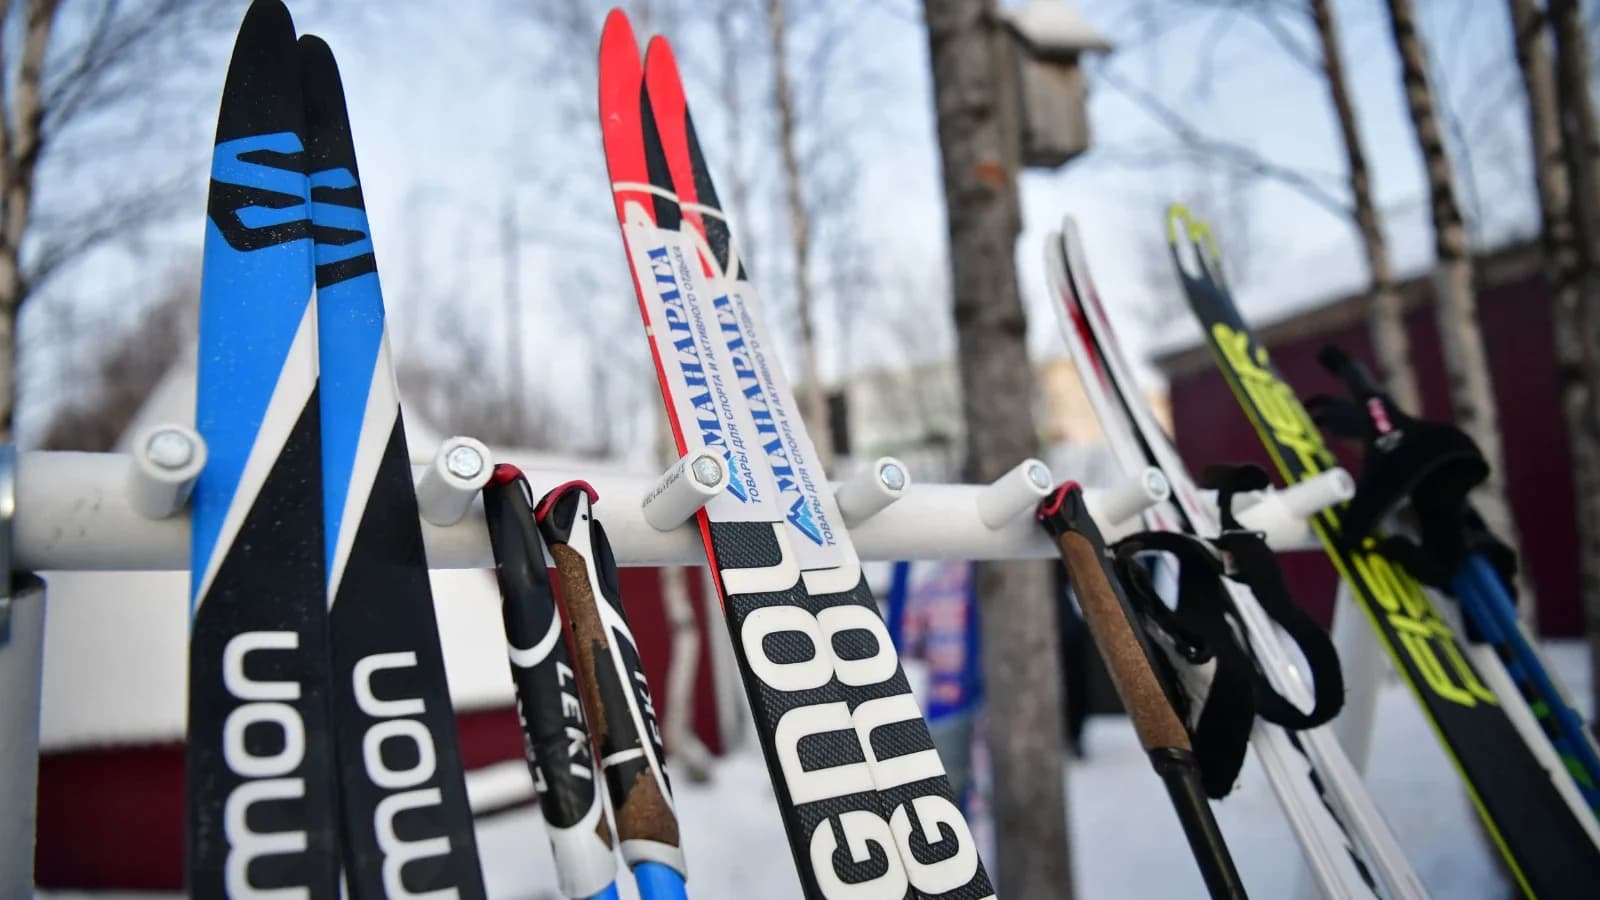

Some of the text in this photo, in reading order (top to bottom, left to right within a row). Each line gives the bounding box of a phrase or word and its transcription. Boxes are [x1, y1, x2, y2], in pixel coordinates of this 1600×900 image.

[647, 245, 729, 449] МАНАРАГА
[708, 362, 718, 371] И
[712, 294, 802, 494] МАНАРАГА
[712, 374, 734, 421] СПОРТА
[776, 408, 786, 417] И
[727, 423, 746, 449] ДЛЯ
[780, 420, 804, 465] СПОРТА
[735, 451, 762, 504] ТОВАРЫ
[798, 467, 817, 494] ДЛЯ
[809, 494, 836, 546] ТОВАРЫ
[556, 661, 592, 780] LEKI
[222, 631, 310, 900] mon
